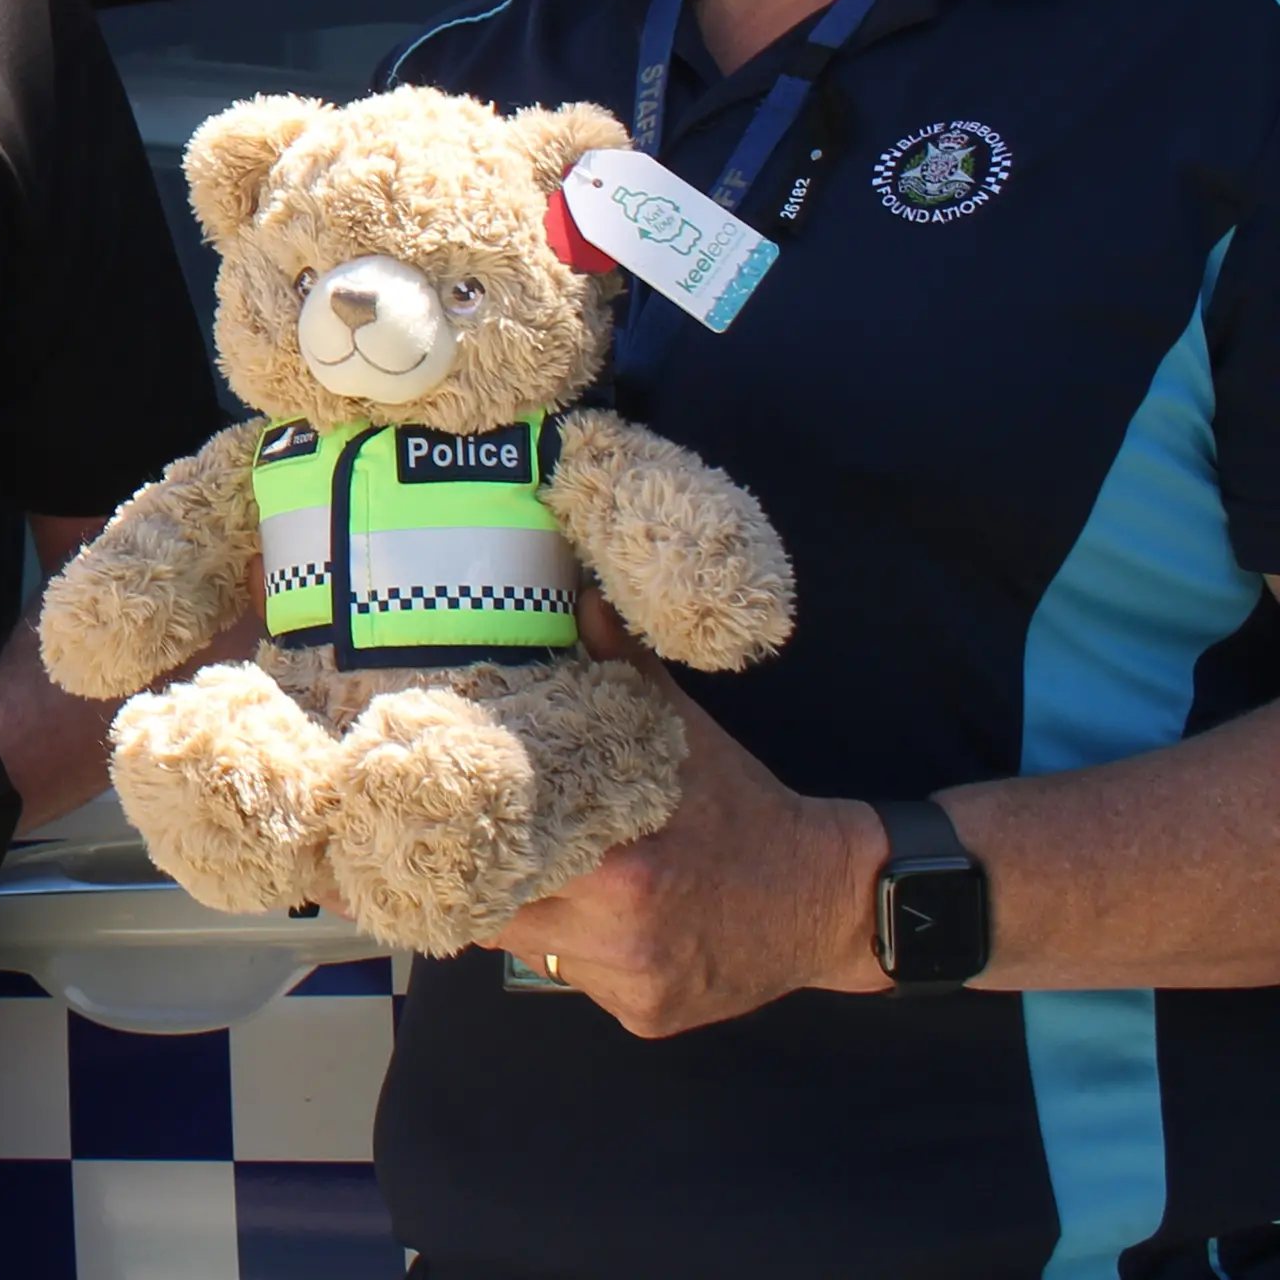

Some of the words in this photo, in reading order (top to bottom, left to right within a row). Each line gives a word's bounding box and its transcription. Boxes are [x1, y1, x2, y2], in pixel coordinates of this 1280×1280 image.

[896, 122, 946, 151] BLUE
[950, 120, 1008, 156] RIBBON
[780, 178, 811, 220] 26182
[876, 186, 989, 224] FOUNDATION
[676, 222, 738, 293] keeleco
[407, 436, 519, 468] Police
